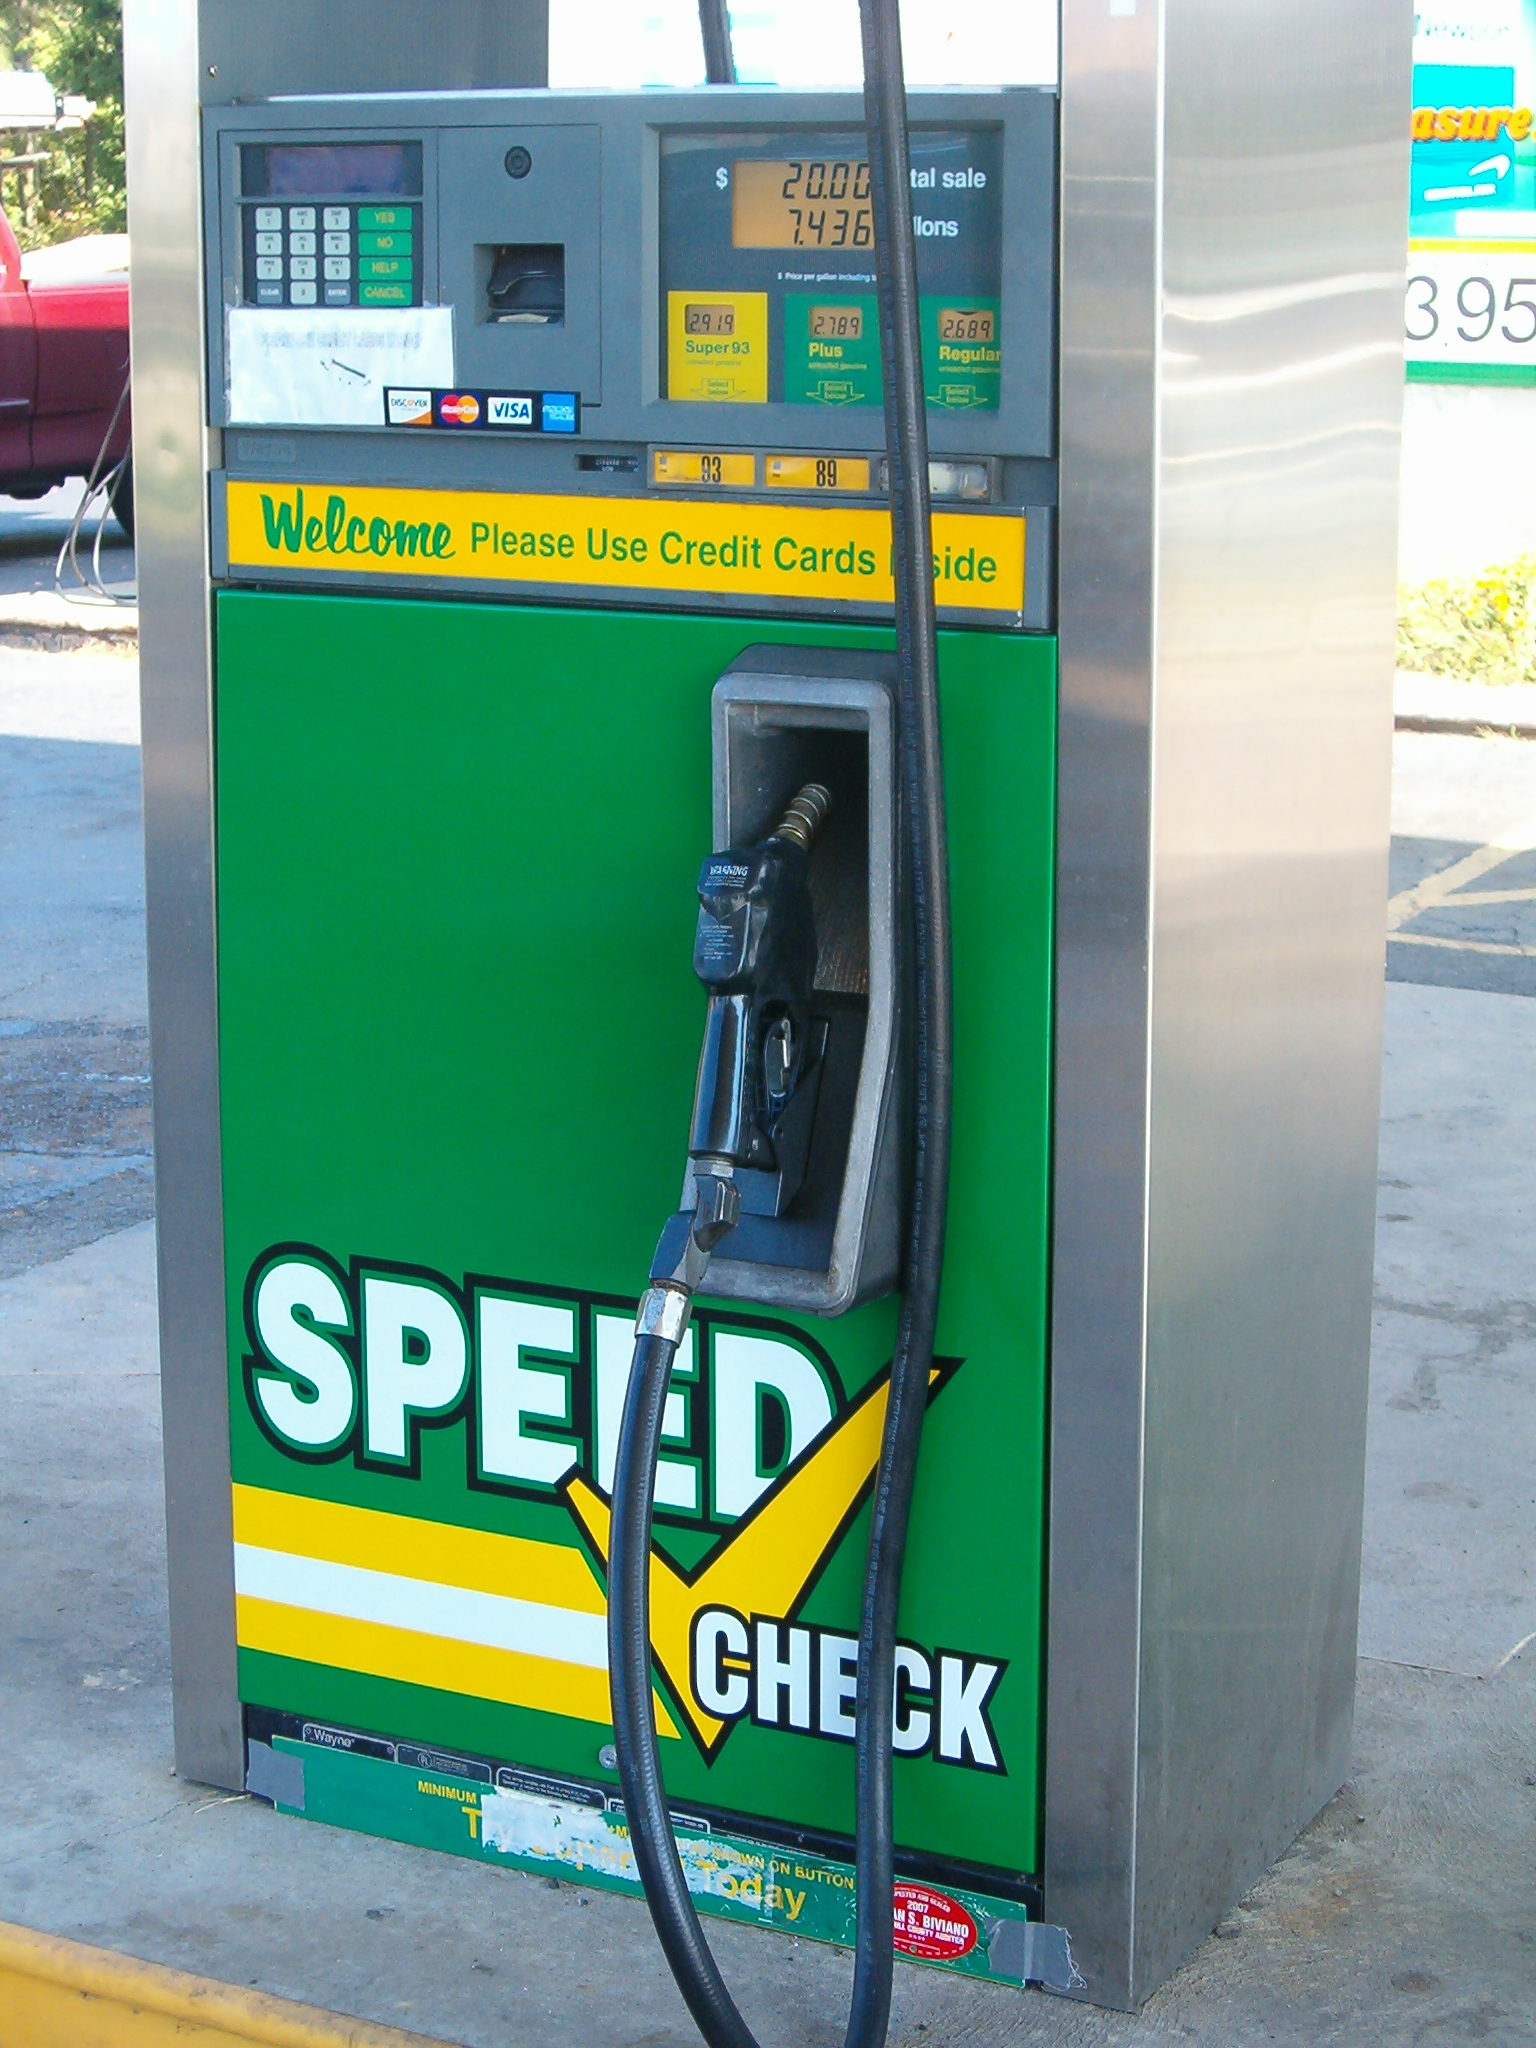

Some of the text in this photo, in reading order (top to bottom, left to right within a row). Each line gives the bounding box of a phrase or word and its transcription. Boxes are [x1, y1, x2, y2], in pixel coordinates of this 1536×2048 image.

[716, 163, 987, 200] $ 20.00 tal sale
[374, 212, 395, 224] YES
[789, 209, 959, 246] 7.436 llons
[376, 236, 394, 248] NO
[371, 262, 398, 274] HELP
[364, 286, 405, 299] CANCEL
[814, 316, 860, 336] 2.789
[685, 340, 750, 356] Super 93
[808, 342, 843, 358] Plus
[939, 345, 1001, 364] Regular
[494, 402, 530, 418] VISA
[701, 455, 722, 483] 93
[816, 459, 838, 488] 89
[260, 487, 457, 559] Welcome
[471, 521, 575, 558] Please
[587, 527, 648, 562] Use
[660, 530, 762, 569] Credit
[774, 536, 876, 575] Cards
[251, 1260, 835, 1521] SPEED
[693, 1609, 1003, 1769] CHECK
[313, 1728, 352, 1748] Wayne
[417, 1780, 477, 1805] MINIMUM
[769, 1859, 791, 1876] ON
[795, 1865, 854, 1890] BUTTON
[695, 1858, 806, 1921] Today
[906, 1900, 929, 1913] 2007
[908, 1911, 919, 1926] S.
[922, 1915, 969, 1939] BIVIANO
